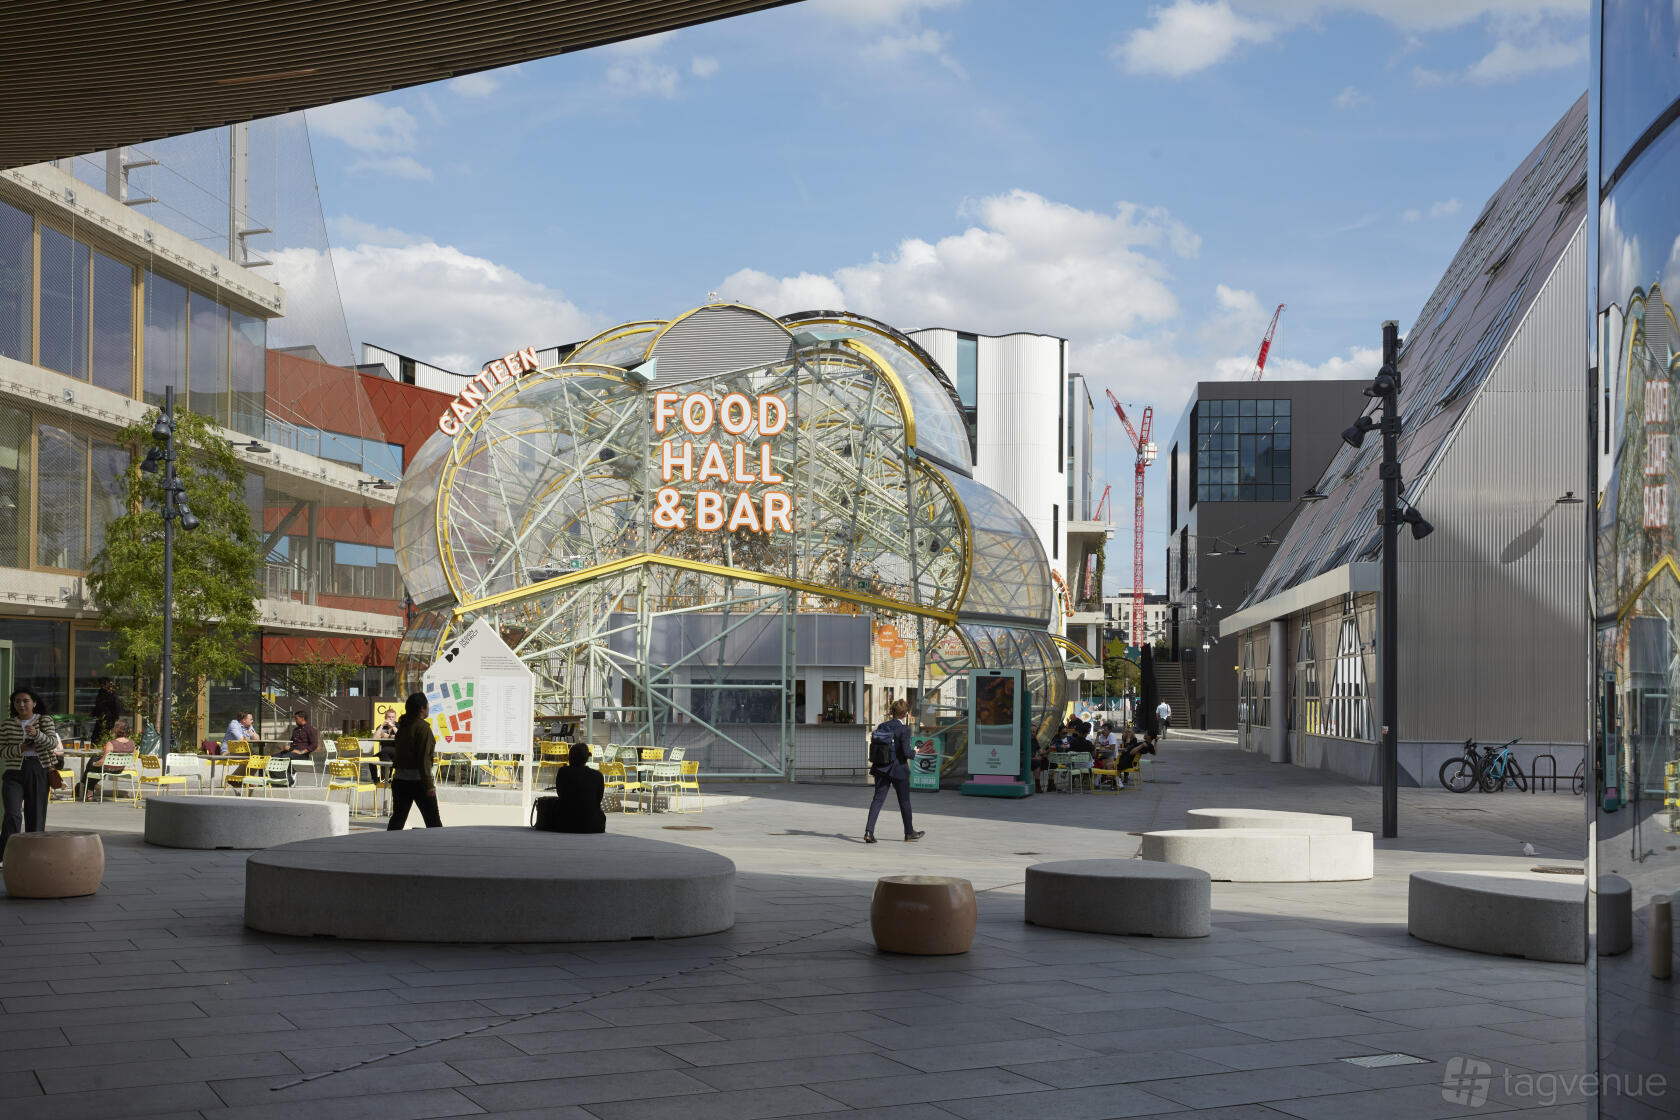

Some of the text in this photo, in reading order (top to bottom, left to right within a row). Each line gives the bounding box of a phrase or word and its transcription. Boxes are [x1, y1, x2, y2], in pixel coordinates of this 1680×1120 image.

[438, 345, 540, 436] CANTEEN
[655, 392, 788, 435] FOOD
[661, 439, 783, 484] HALL
[652, 486, 793, 533] & BAR
